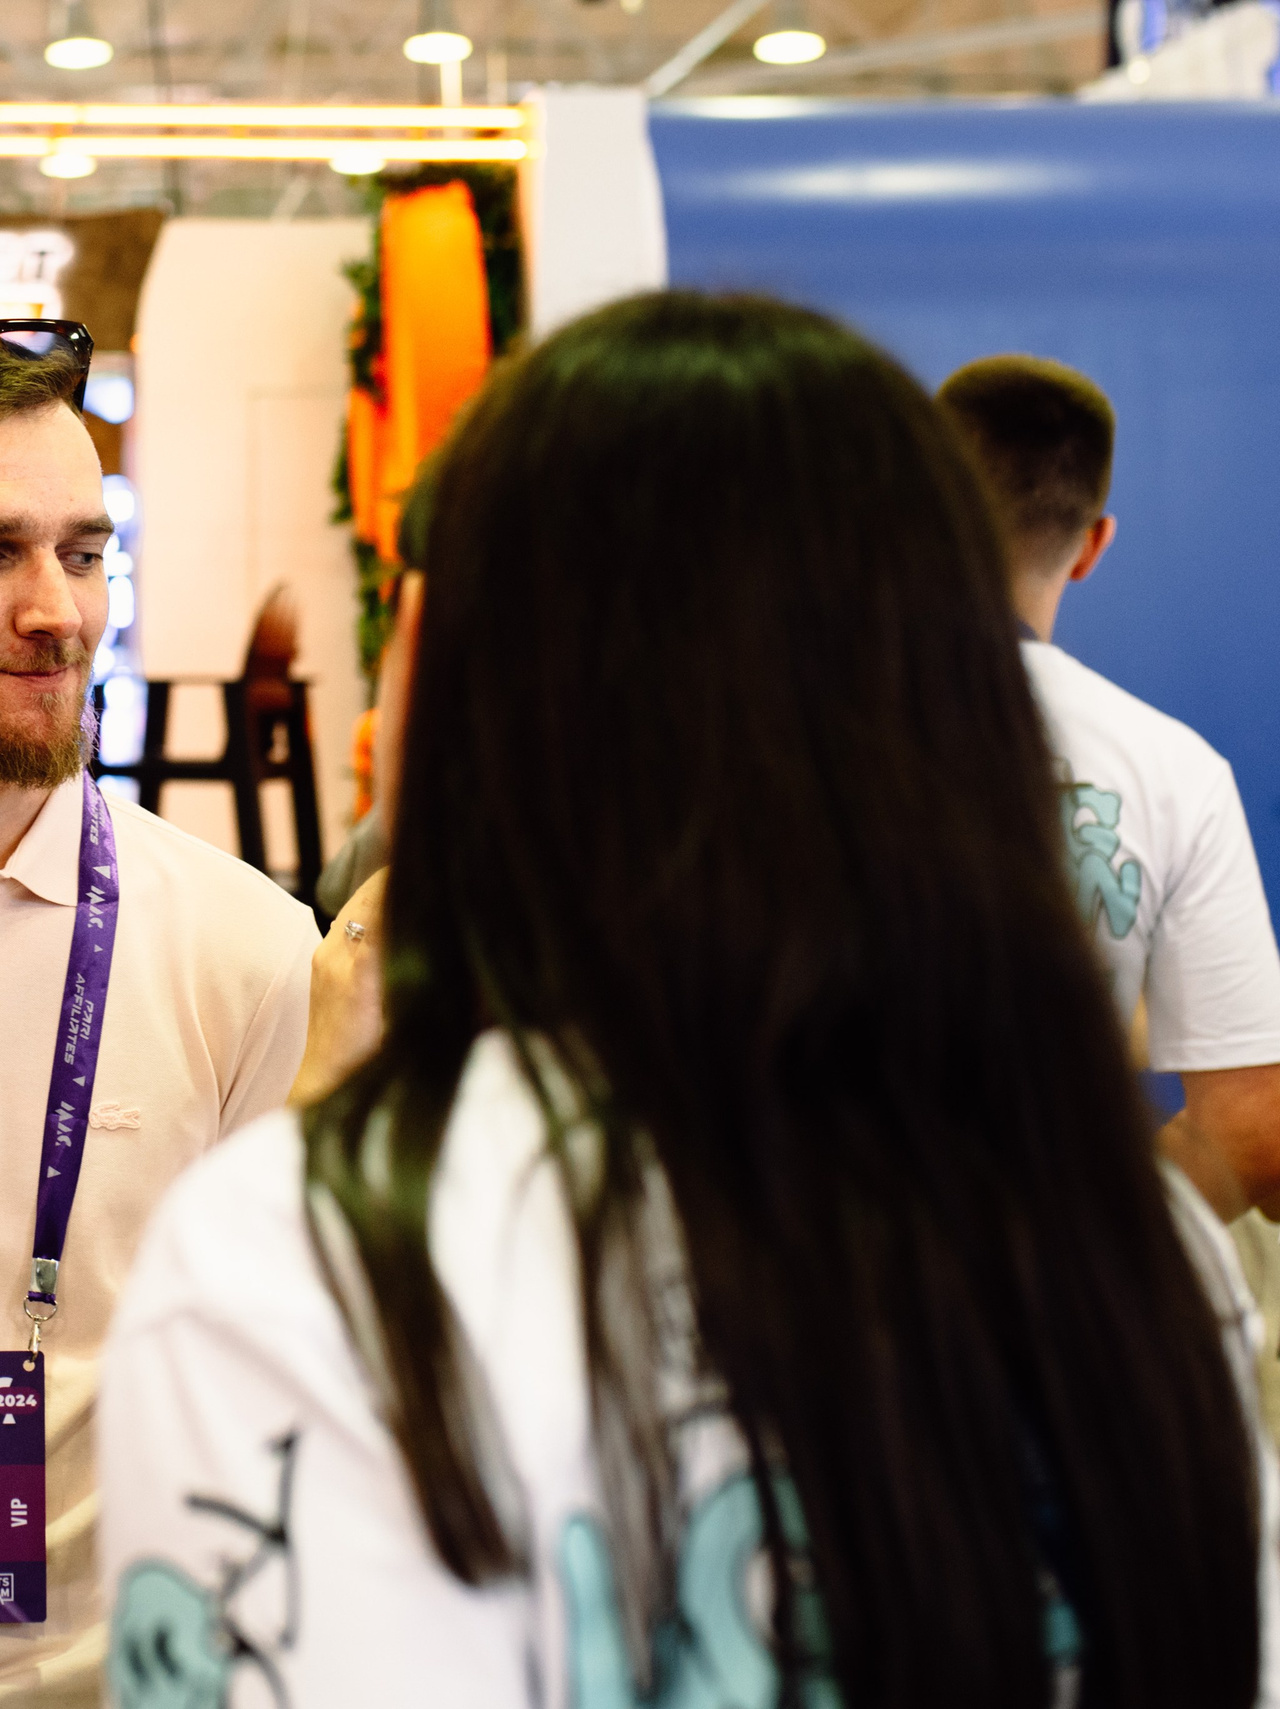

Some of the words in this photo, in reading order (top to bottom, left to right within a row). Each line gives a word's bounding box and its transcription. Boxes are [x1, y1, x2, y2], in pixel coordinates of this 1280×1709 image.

[63, 972, 87, 1066] AFFILIATES
[79, 998, 94, 1041] PARI
[10, 1497, 28, 1528] VIP
